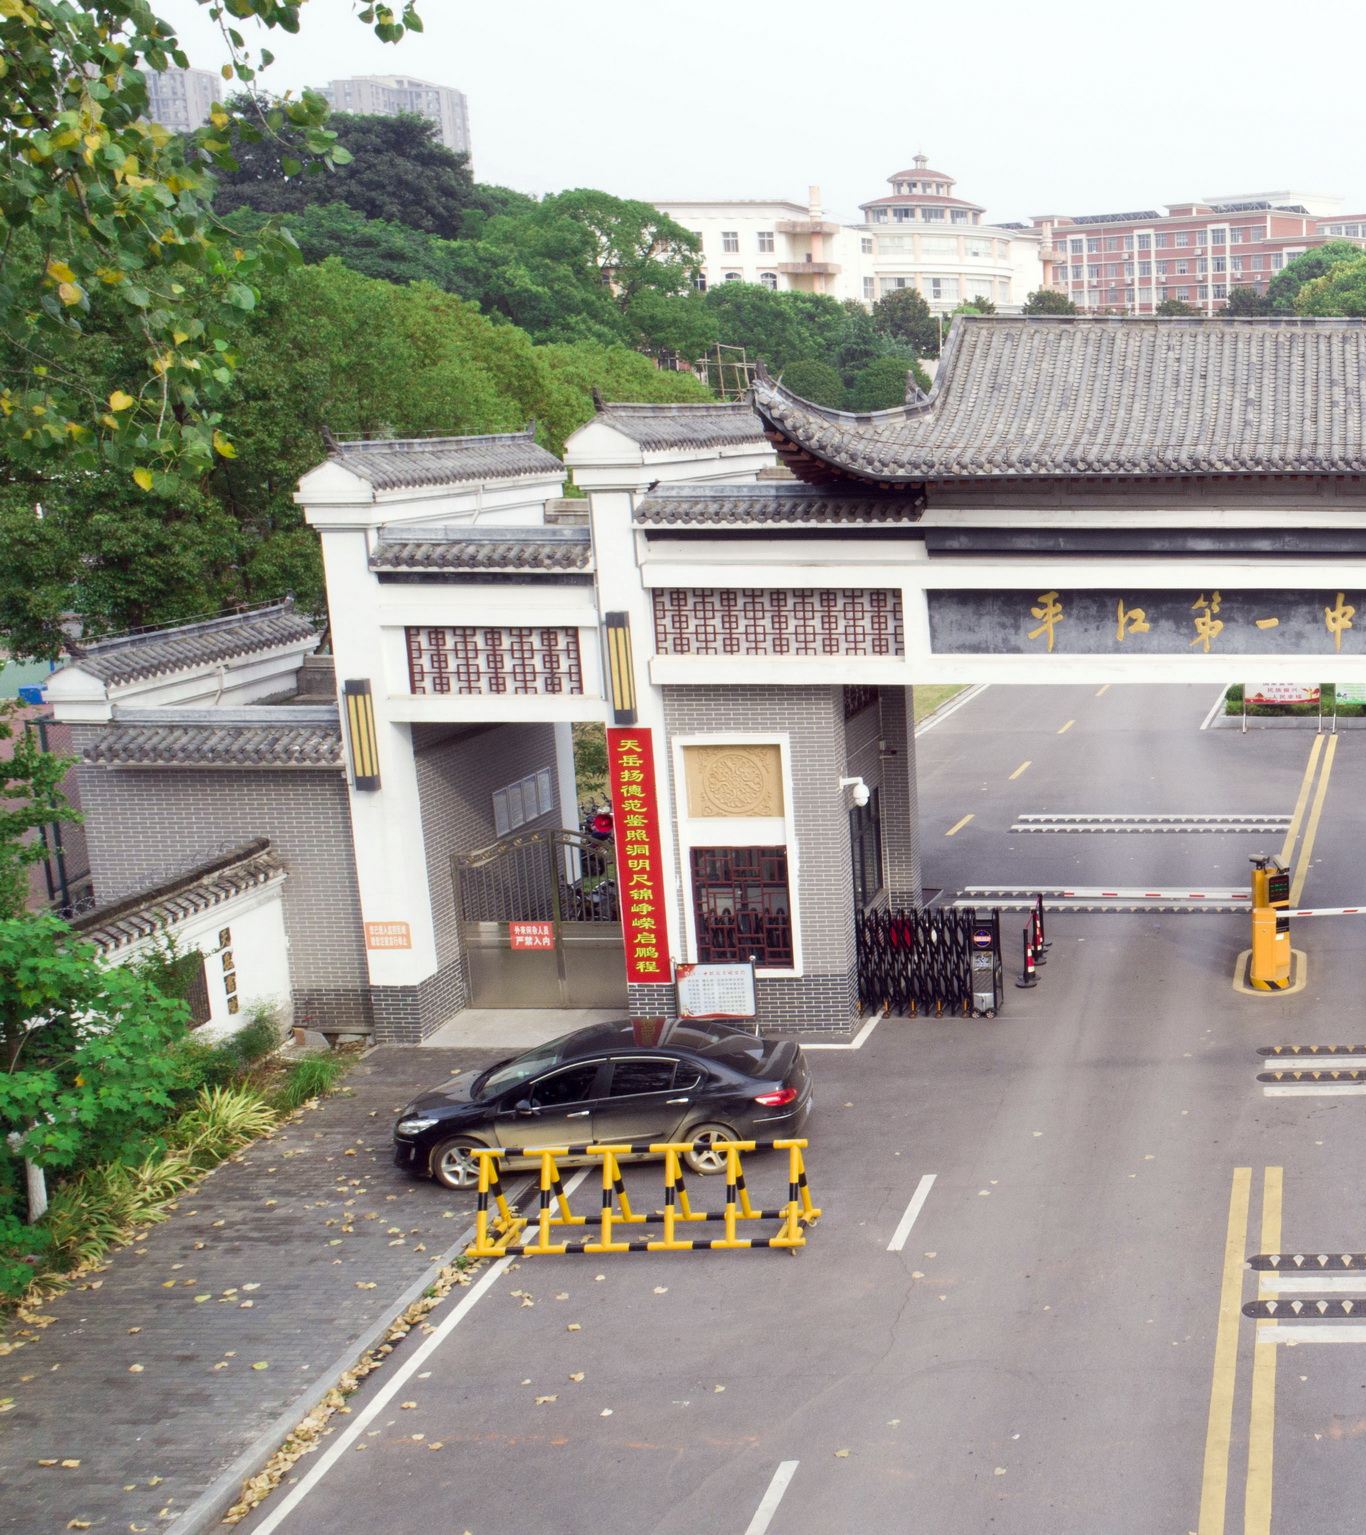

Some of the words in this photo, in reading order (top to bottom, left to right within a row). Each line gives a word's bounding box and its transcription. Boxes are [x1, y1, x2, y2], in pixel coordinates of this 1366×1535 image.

[514, 925, 550, 936] 外来闲杂人员
[515, 936, 551, 946] 严禁入内
